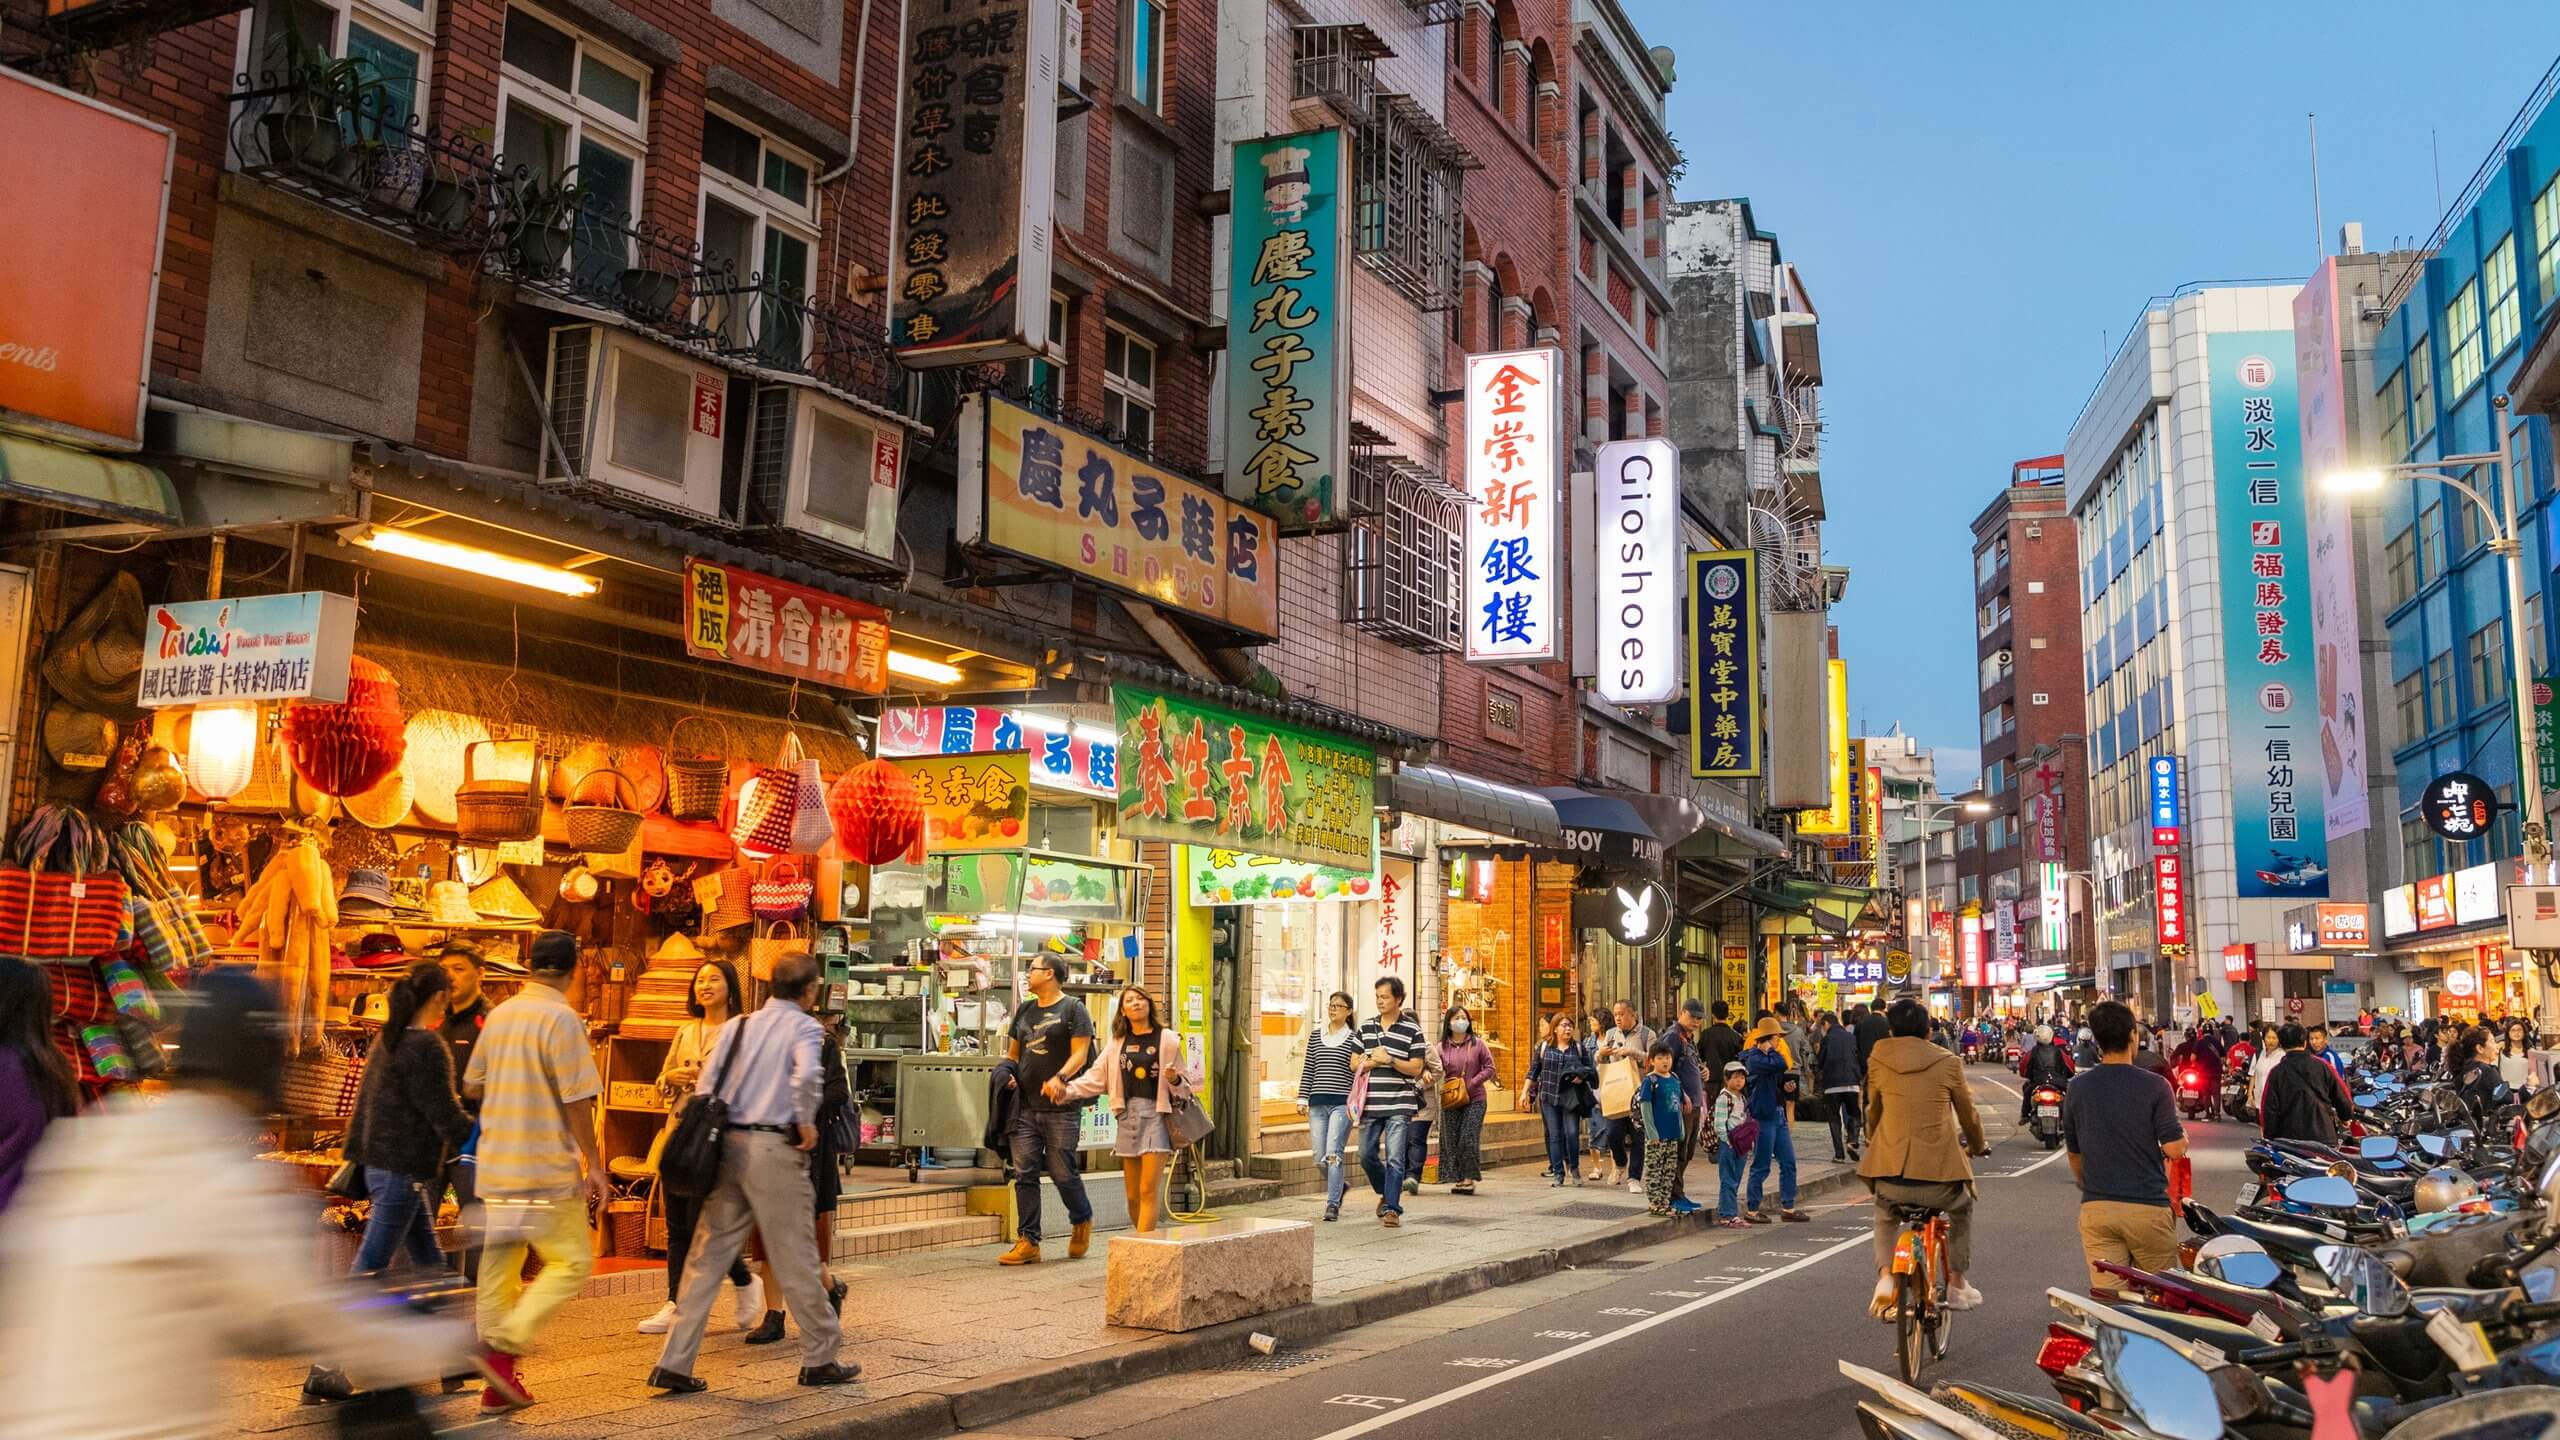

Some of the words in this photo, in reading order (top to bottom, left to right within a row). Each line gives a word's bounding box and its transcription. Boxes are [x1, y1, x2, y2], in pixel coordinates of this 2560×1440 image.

[699, 390, 718, 437] 禾聯
[1243, 229, 1319, 495] 慶丸子素食
[878, 445, 896, 487] 禾聯
[1018, 426, 1259, 583] 慶丸子鞋店
[1480, 364, 1540, 645] 金崇新銀樓
[2244, 398, 2280, 504] 淡水一信
[697, 569, 724, 646] 絕版
[1620, 455, 1653, 690] Gioshoes
[2251, 553, 2288, 664] 福勝證券
[142, 658, 310, 700] 國民旅遊卡特約商店
[1708, 604, 1742, 768] 萬寶堂中藥房
[1136, 704, 1294, 833] 養生素食
[2264, 724, 2296, 841] 一信幼兒園
[1560, 829, 1603, 853] BOY
[1378, 873, 1402, 973] 金崇新
